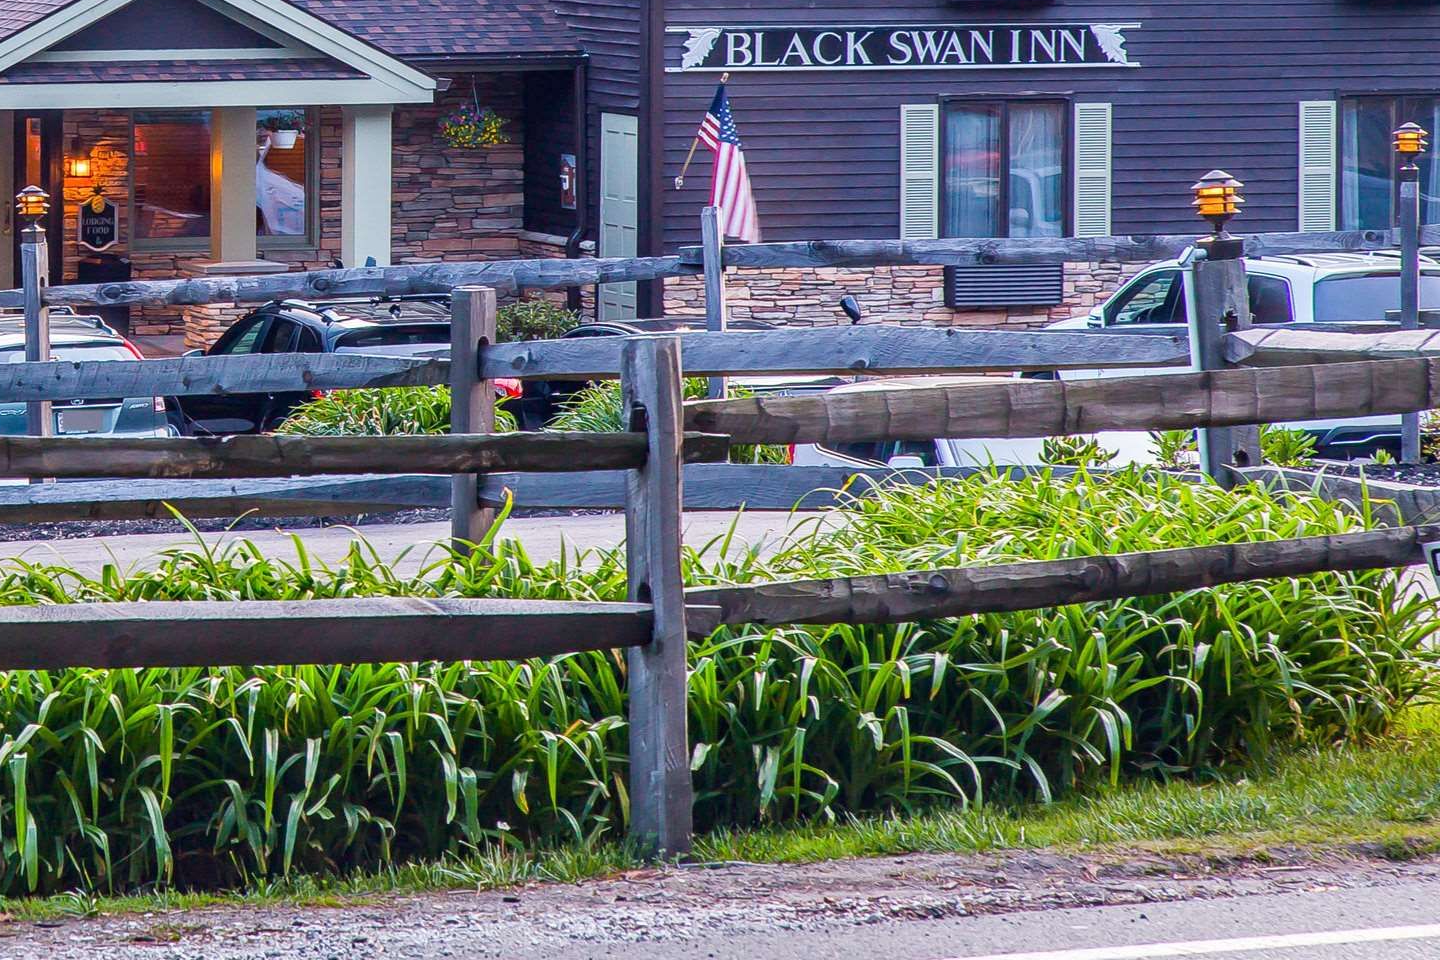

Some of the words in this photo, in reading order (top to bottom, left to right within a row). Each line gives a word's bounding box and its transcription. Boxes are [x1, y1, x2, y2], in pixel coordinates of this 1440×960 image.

[725, 30, 874, 66] BLACK
[886, 30, 994, 65] SWAN
[1009, 29, 1087, 64] INN
[87, 226, 110, 234] FOOD
